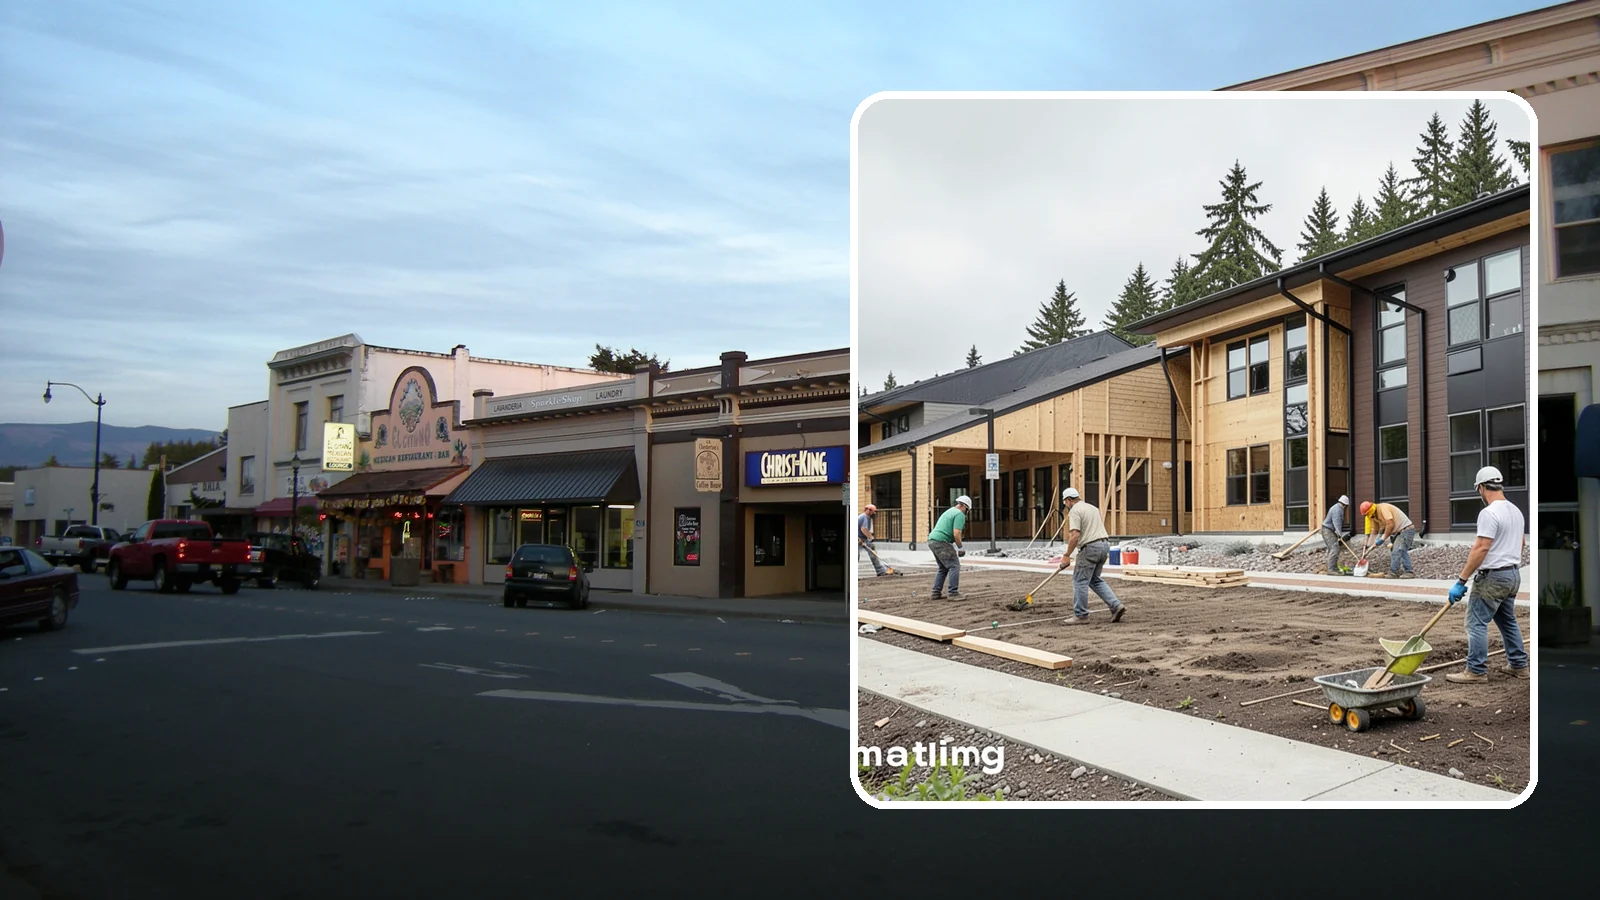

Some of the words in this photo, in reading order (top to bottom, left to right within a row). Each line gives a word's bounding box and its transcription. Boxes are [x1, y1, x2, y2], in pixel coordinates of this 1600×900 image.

[493, 402, 522, 412] LAVANDERIA
[562, 394, 582, 404] Shop
[596, 388, 623, 400] LAUNDRY
[398, 451, 433, 462] RESTAURANT
[761, 452, 797, 478] CHRIST
[799, 450, 827, 476] KING
